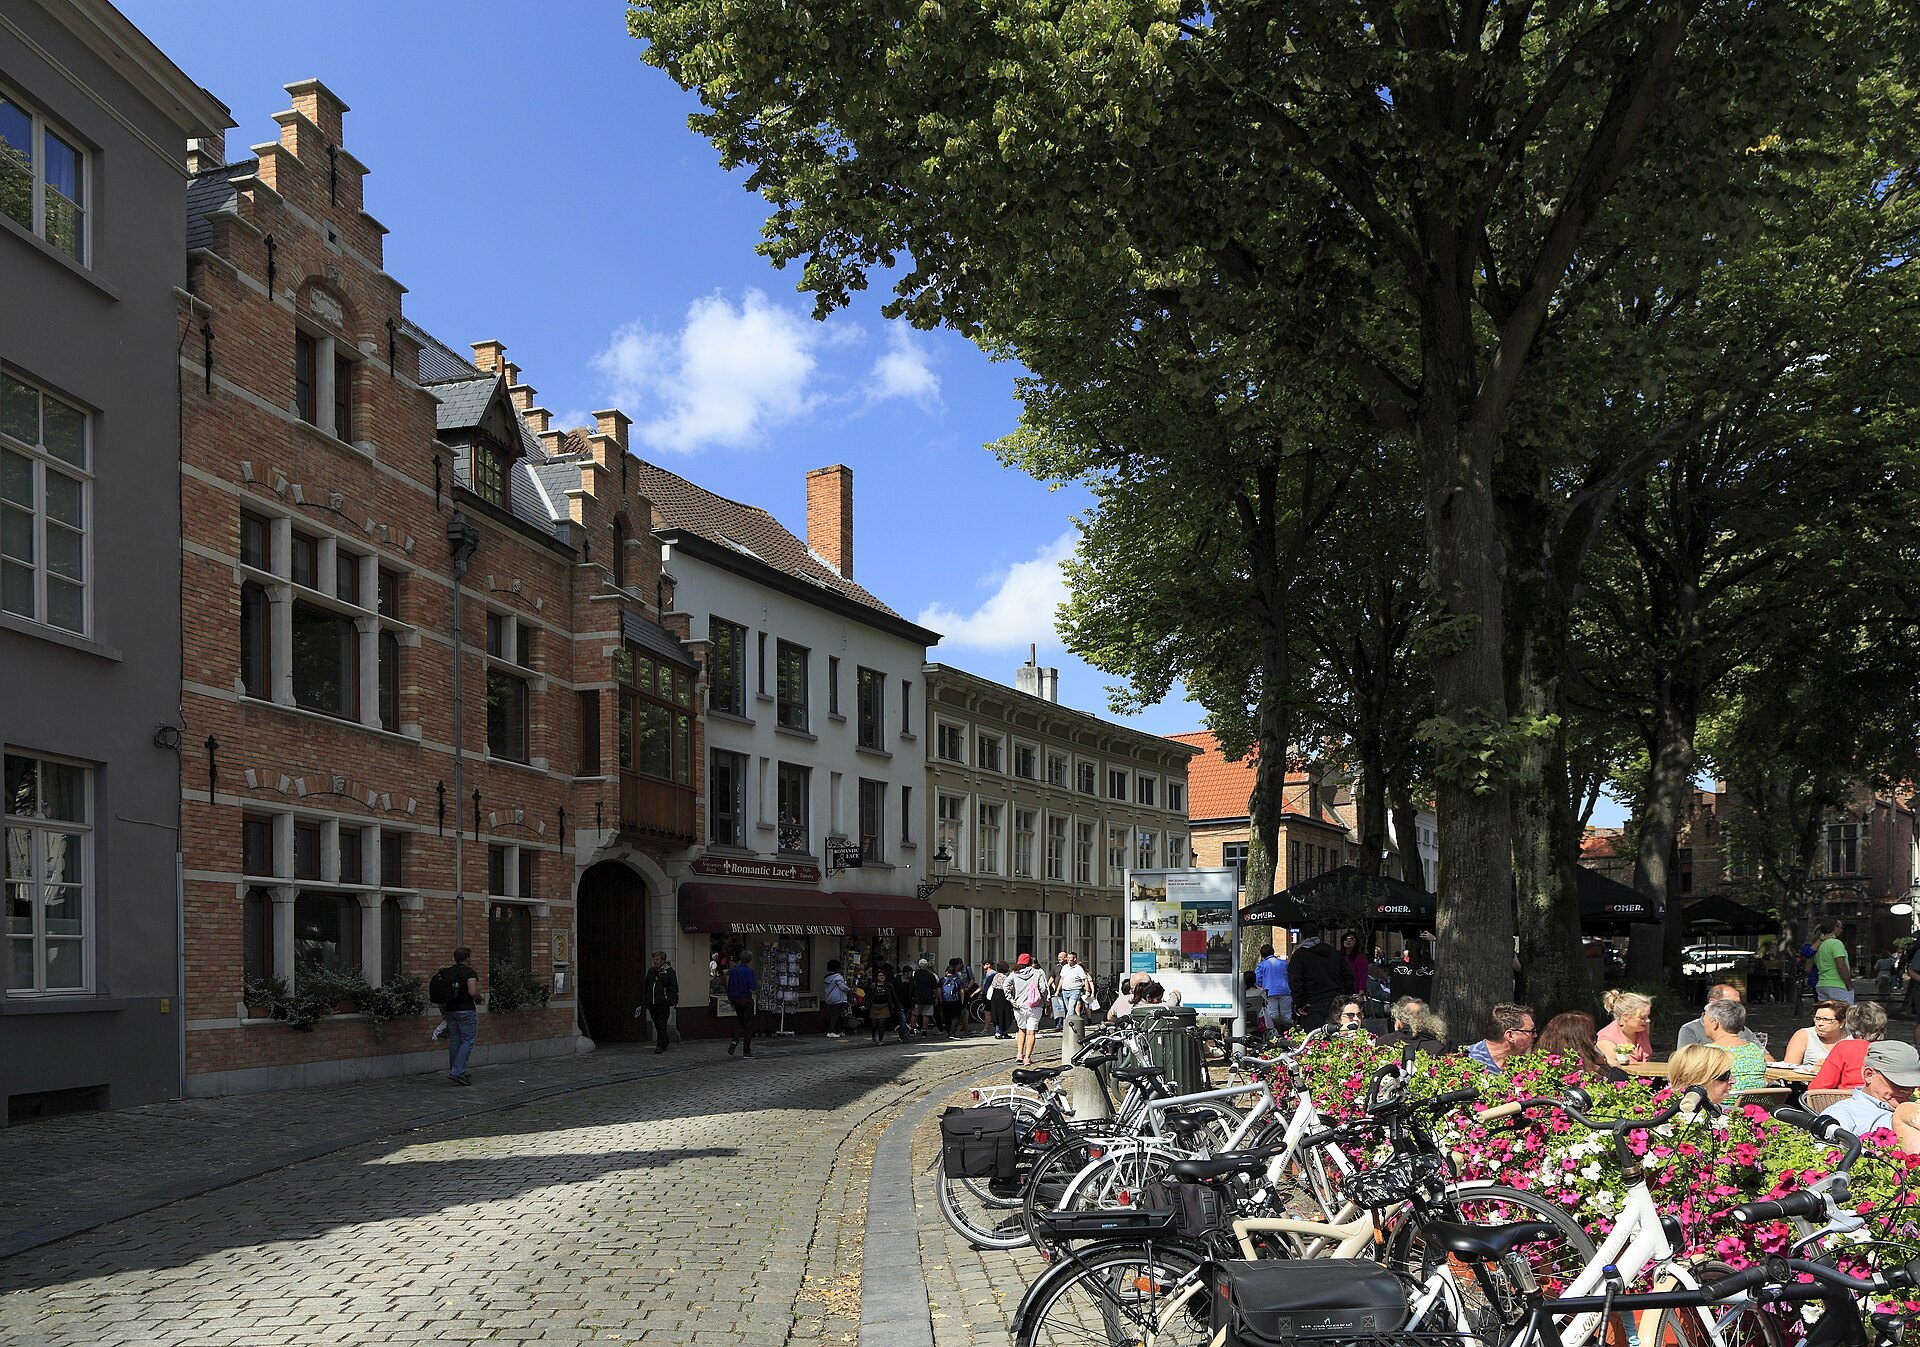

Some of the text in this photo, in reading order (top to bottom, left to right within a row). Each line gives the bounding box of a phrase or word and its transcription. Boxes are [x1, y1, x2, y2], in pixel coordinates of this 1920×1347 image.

[731, 863, 790, 877] Romantic Lace
[731, 923, 845, 936] BELGIAN TAPESTRY SOUVENIRS
[878, 927, 933, 937] LACE GIFTS
[1415, 966, 1434, 977] Ze
